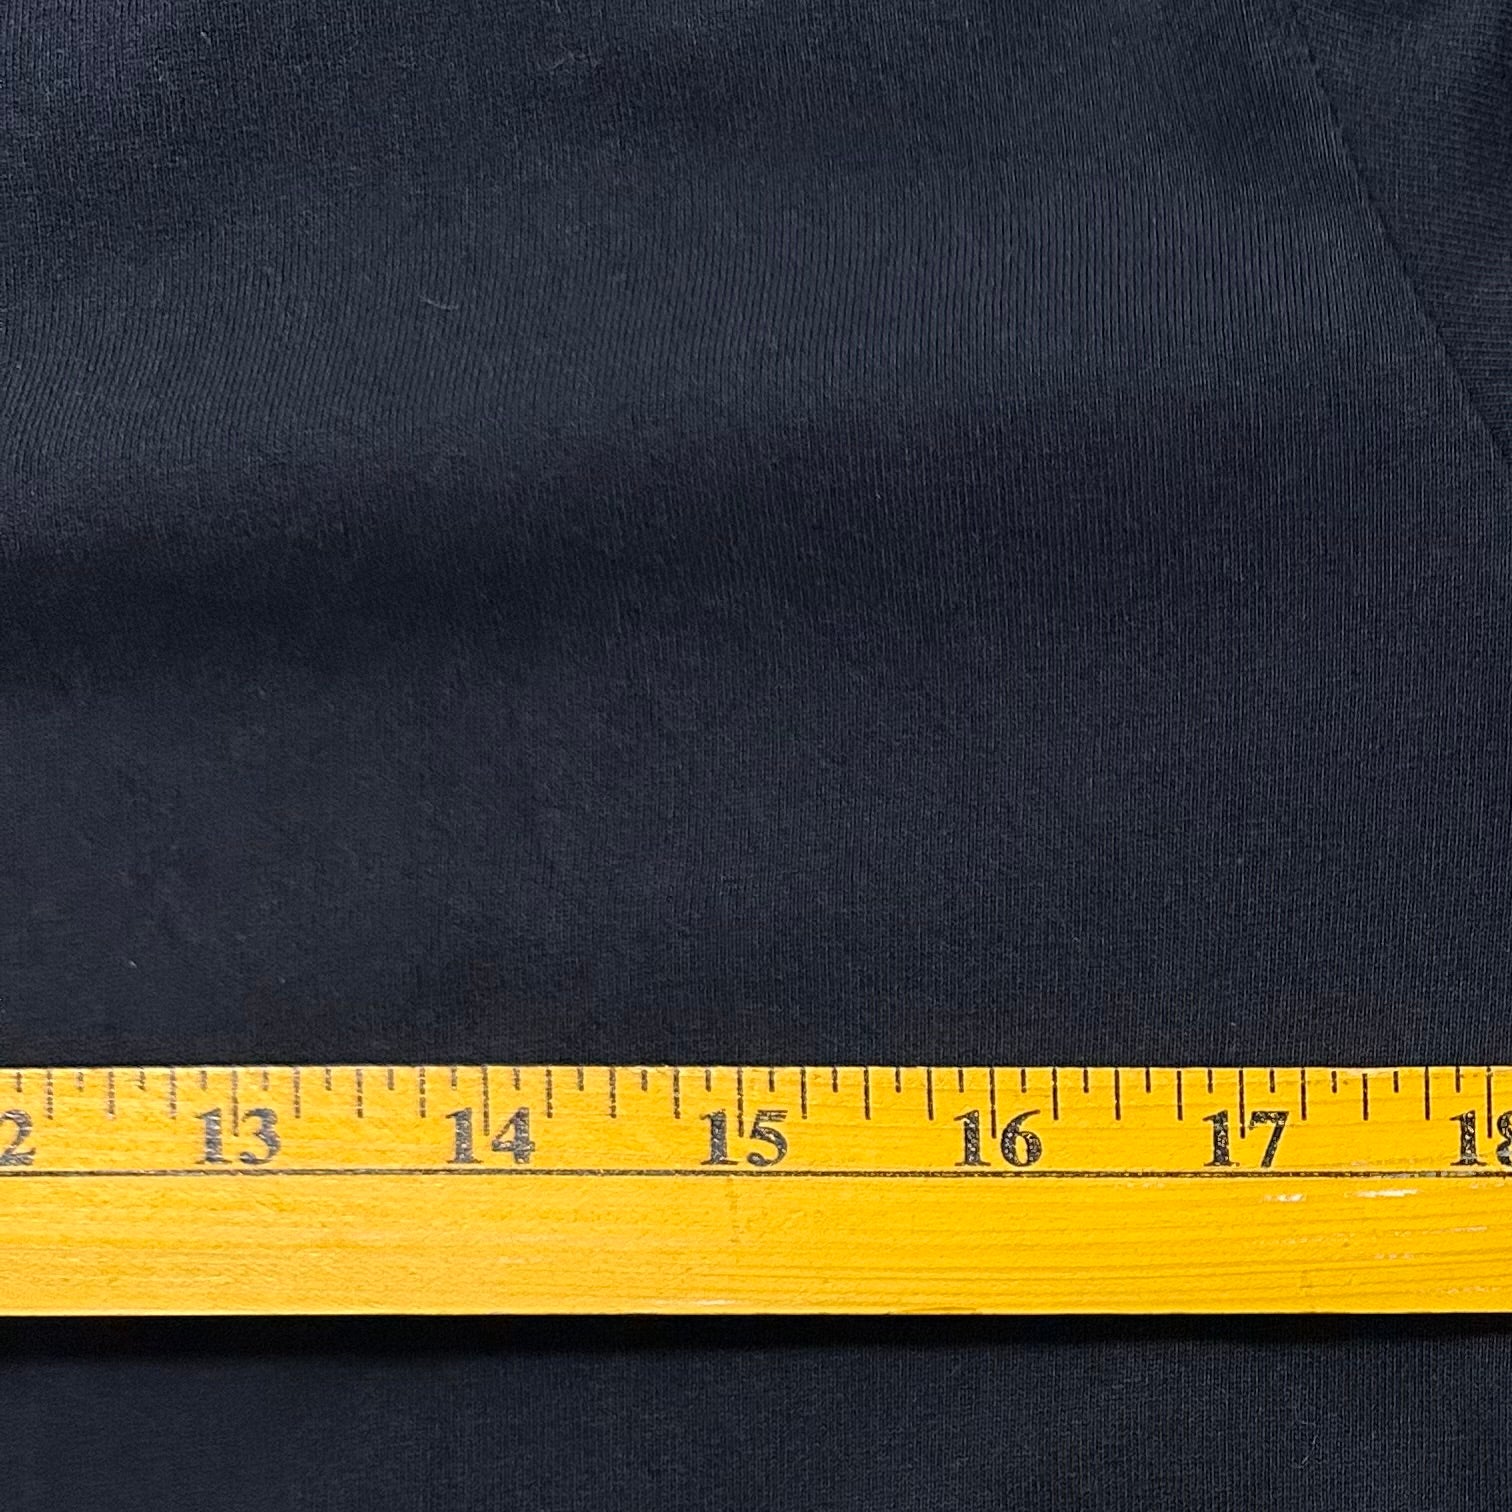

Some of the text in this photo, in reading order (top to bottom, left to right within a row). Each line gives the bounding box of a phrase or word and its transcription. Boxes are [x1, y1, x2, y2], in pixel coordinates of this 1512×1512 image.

[0, 1109, 36, 1166] 2
[195, 1107, 281, 1165] 13
[445, 1107, 535, 1164] 14
[700, 1109, 788, 1166] 15
[953, 1109, 1042, 1167] 16
[1202, 1109, 1289, 1167] 17
